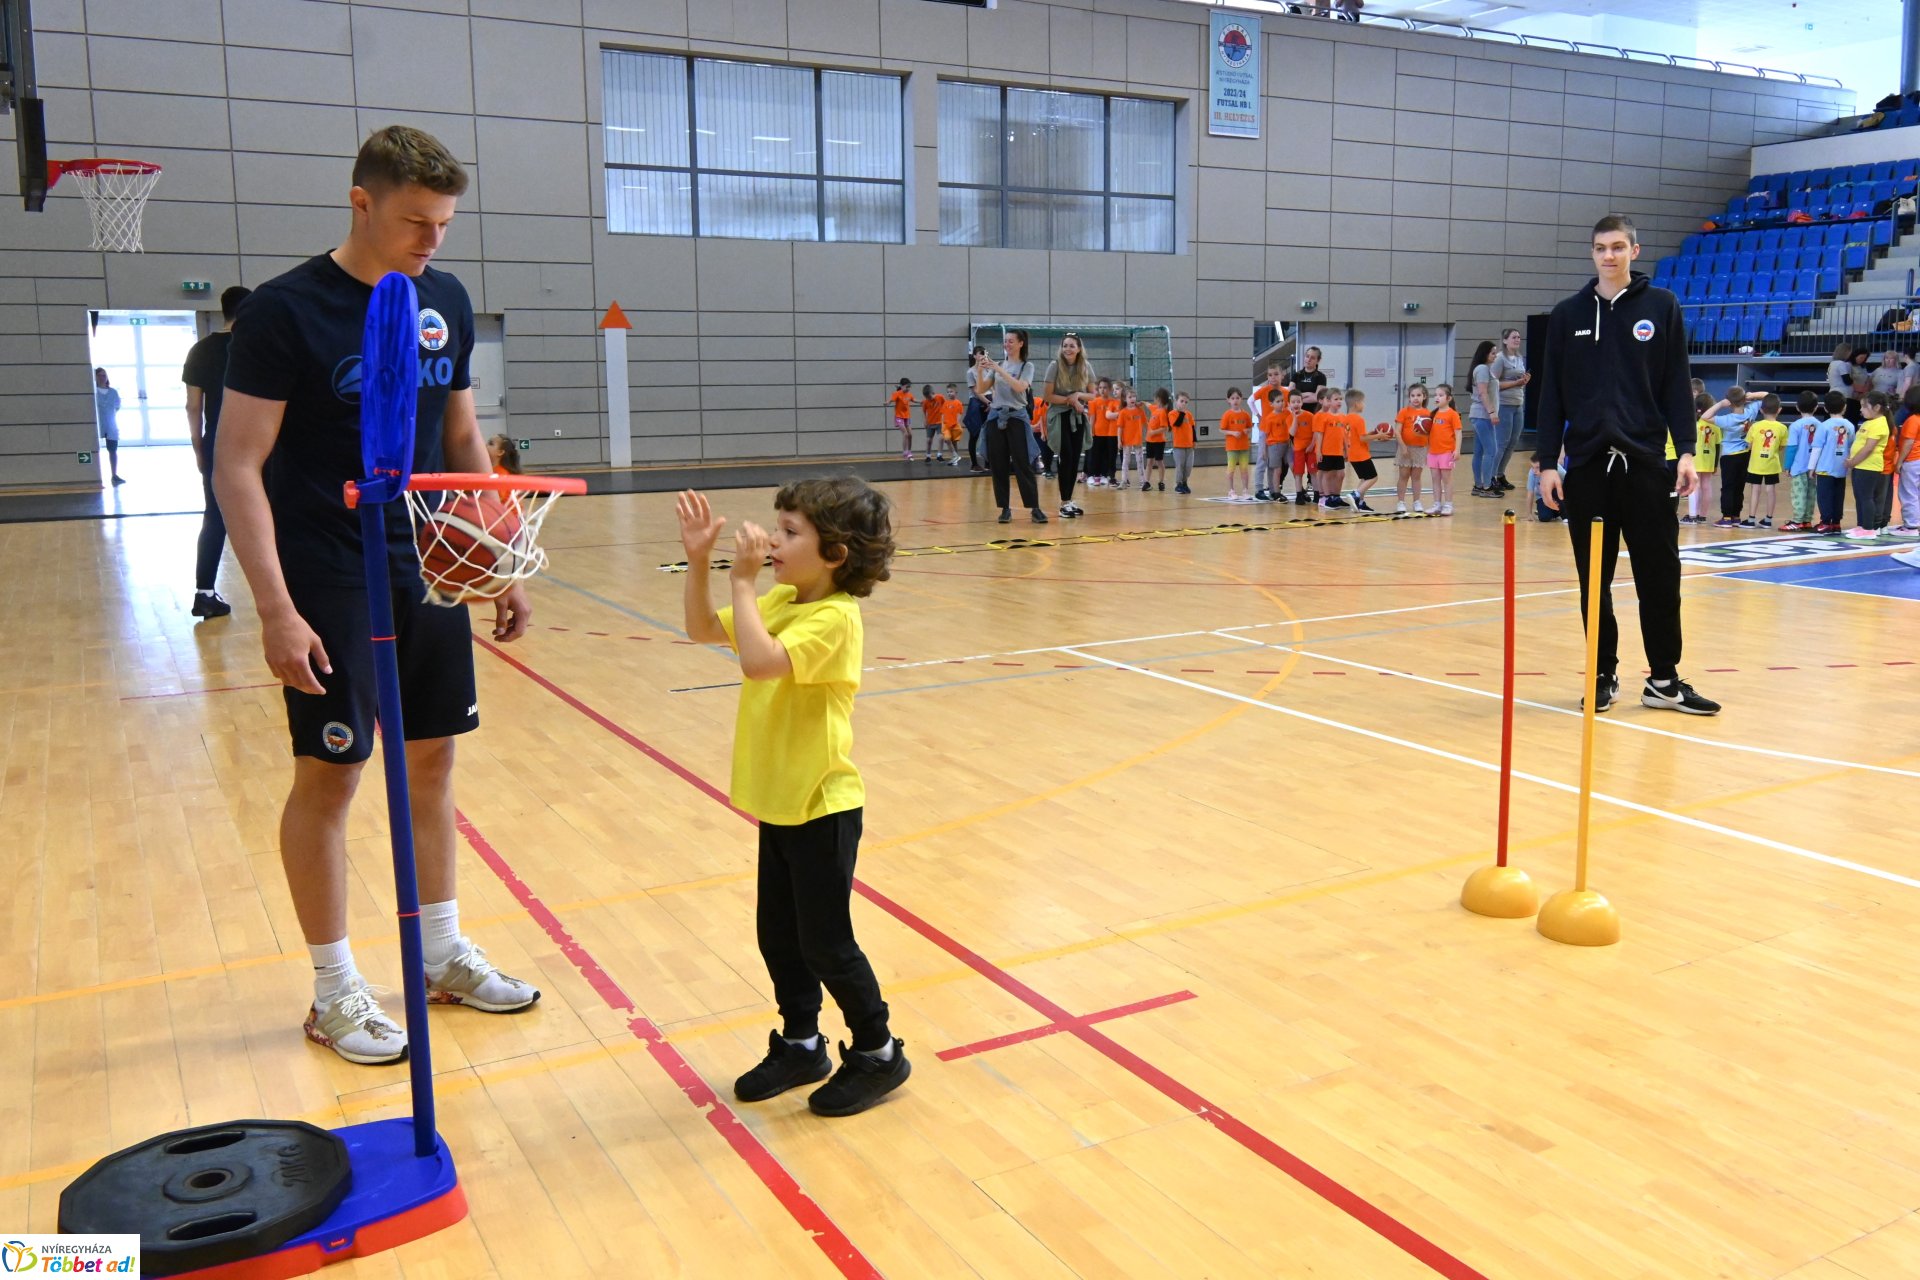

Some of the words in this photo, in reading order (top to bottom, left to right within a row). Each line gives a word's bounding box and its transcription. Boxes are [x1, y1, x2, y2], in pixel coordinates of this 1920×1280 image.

[1224, 88, 1246, 98] 2023/24
[1217, 98, 1238, 108] FUTSAL
[1239, 100, 1247, 109] NB
[417, 356, 454, 388] KO
